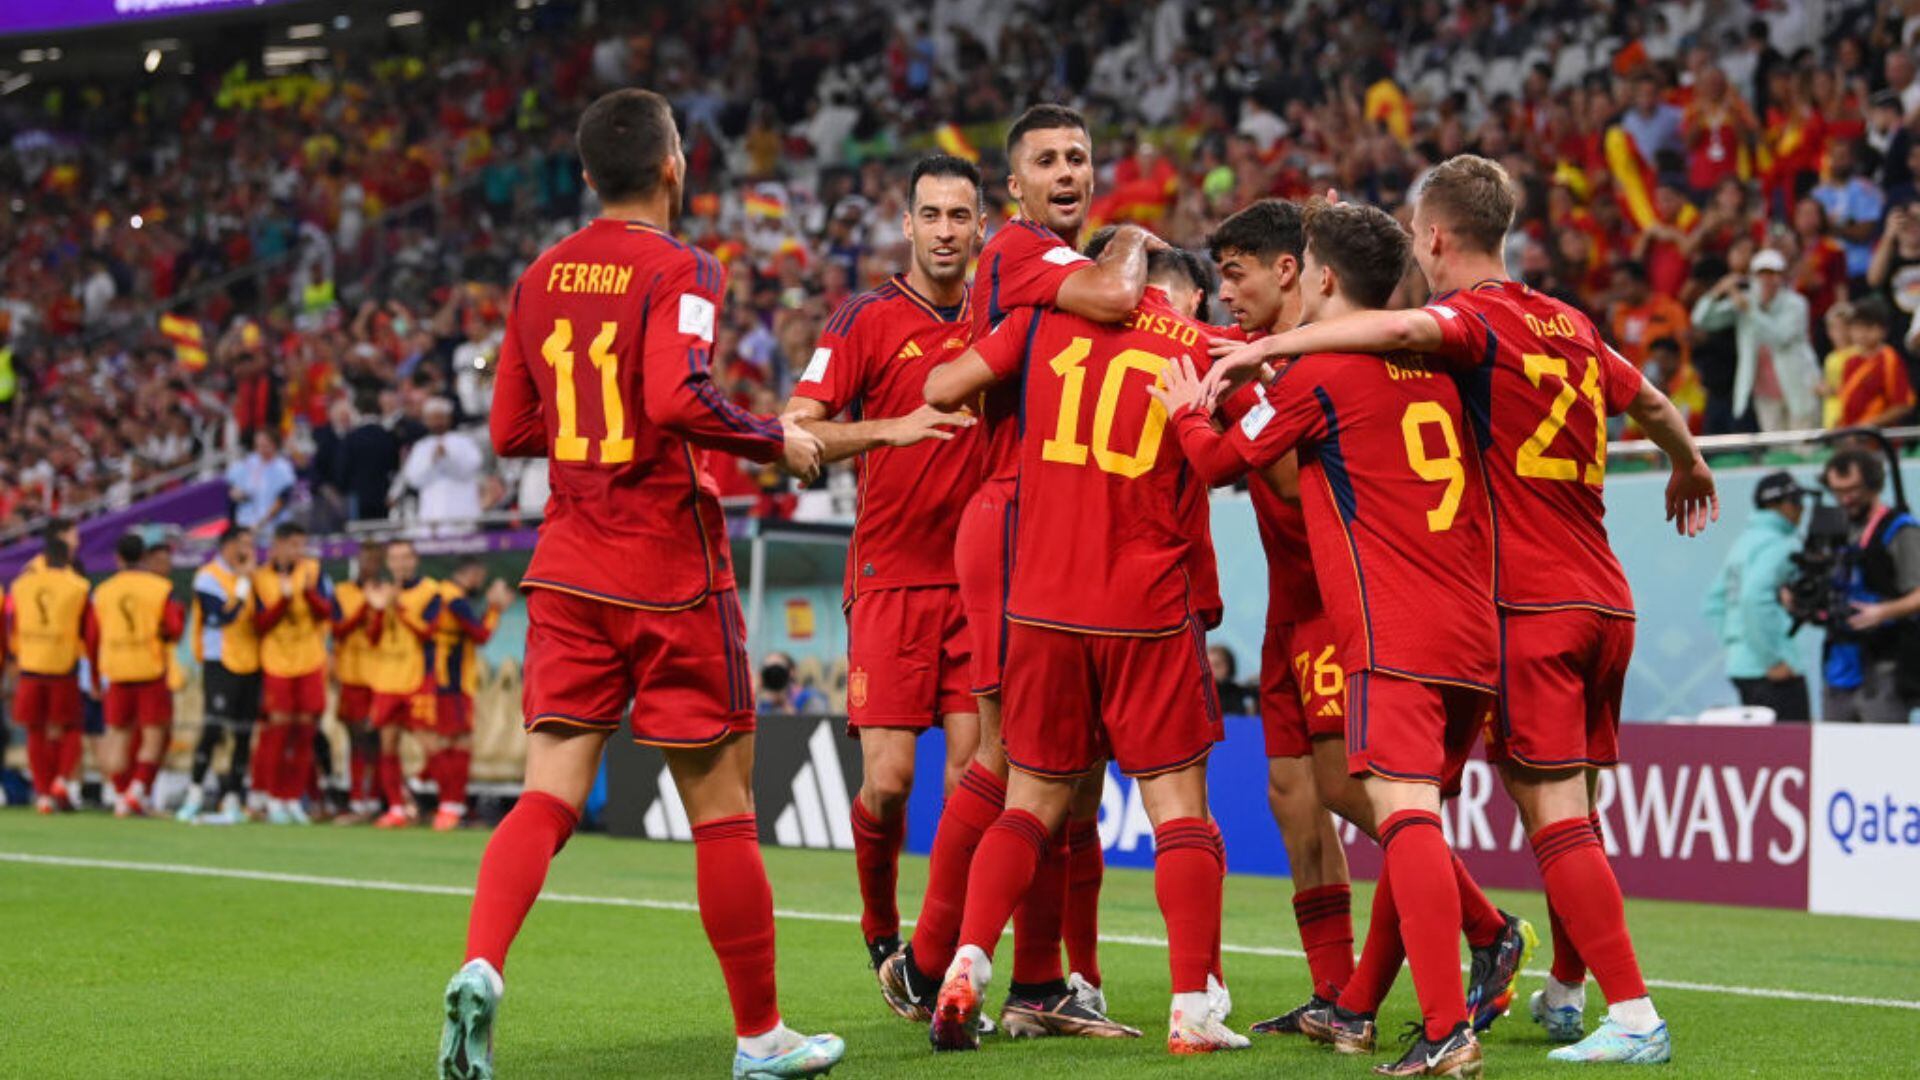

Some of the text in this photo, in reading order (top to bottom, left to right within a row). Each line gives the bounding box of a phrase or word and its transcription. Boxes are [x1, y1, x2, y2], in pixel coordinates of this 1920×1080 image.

[547, 263, 634, 294] FERRAN
[1124, 307, 1199, 347] NSIO
[541, 318, 635, 463] 11
[1042, 336, 1171, 479] 10
[1515, 352, 1608, 487] 21
[1401, 401, 1466, 532] 9
[1295, 644, 1344, 706] 26
[1827, 790, 1920, 855] Qata
